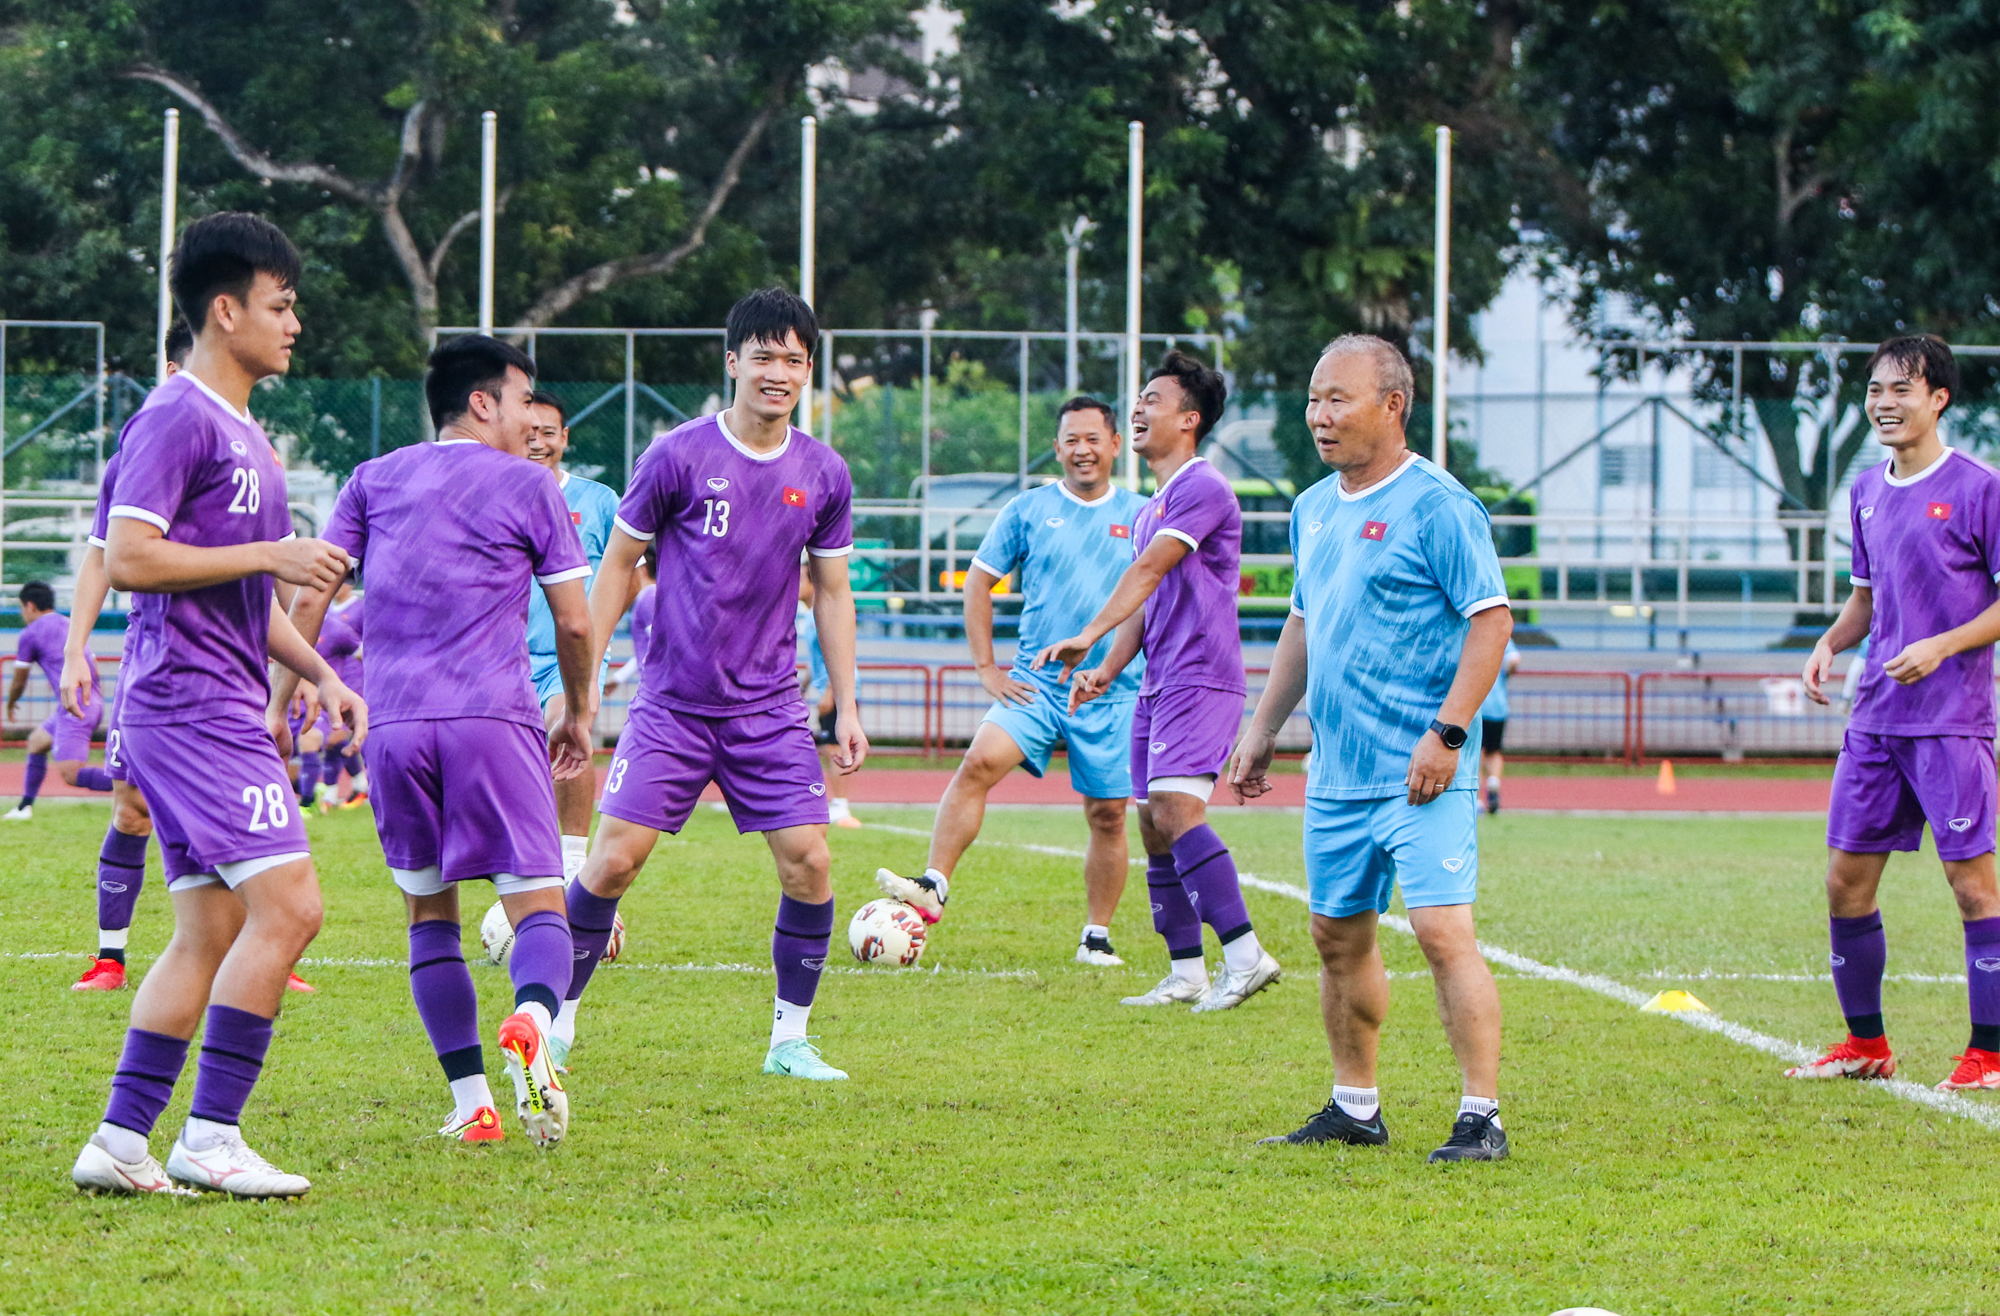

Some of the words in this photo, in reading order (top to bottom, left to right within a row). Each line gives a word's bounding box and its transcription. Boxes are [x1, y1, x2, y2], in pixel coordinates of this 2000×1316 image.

[227, 467, 260, 515] 28
[702, 499, 731, 538] 13
[605, 756, 629, 794] 13
[242, 782, 289, 832] 28
